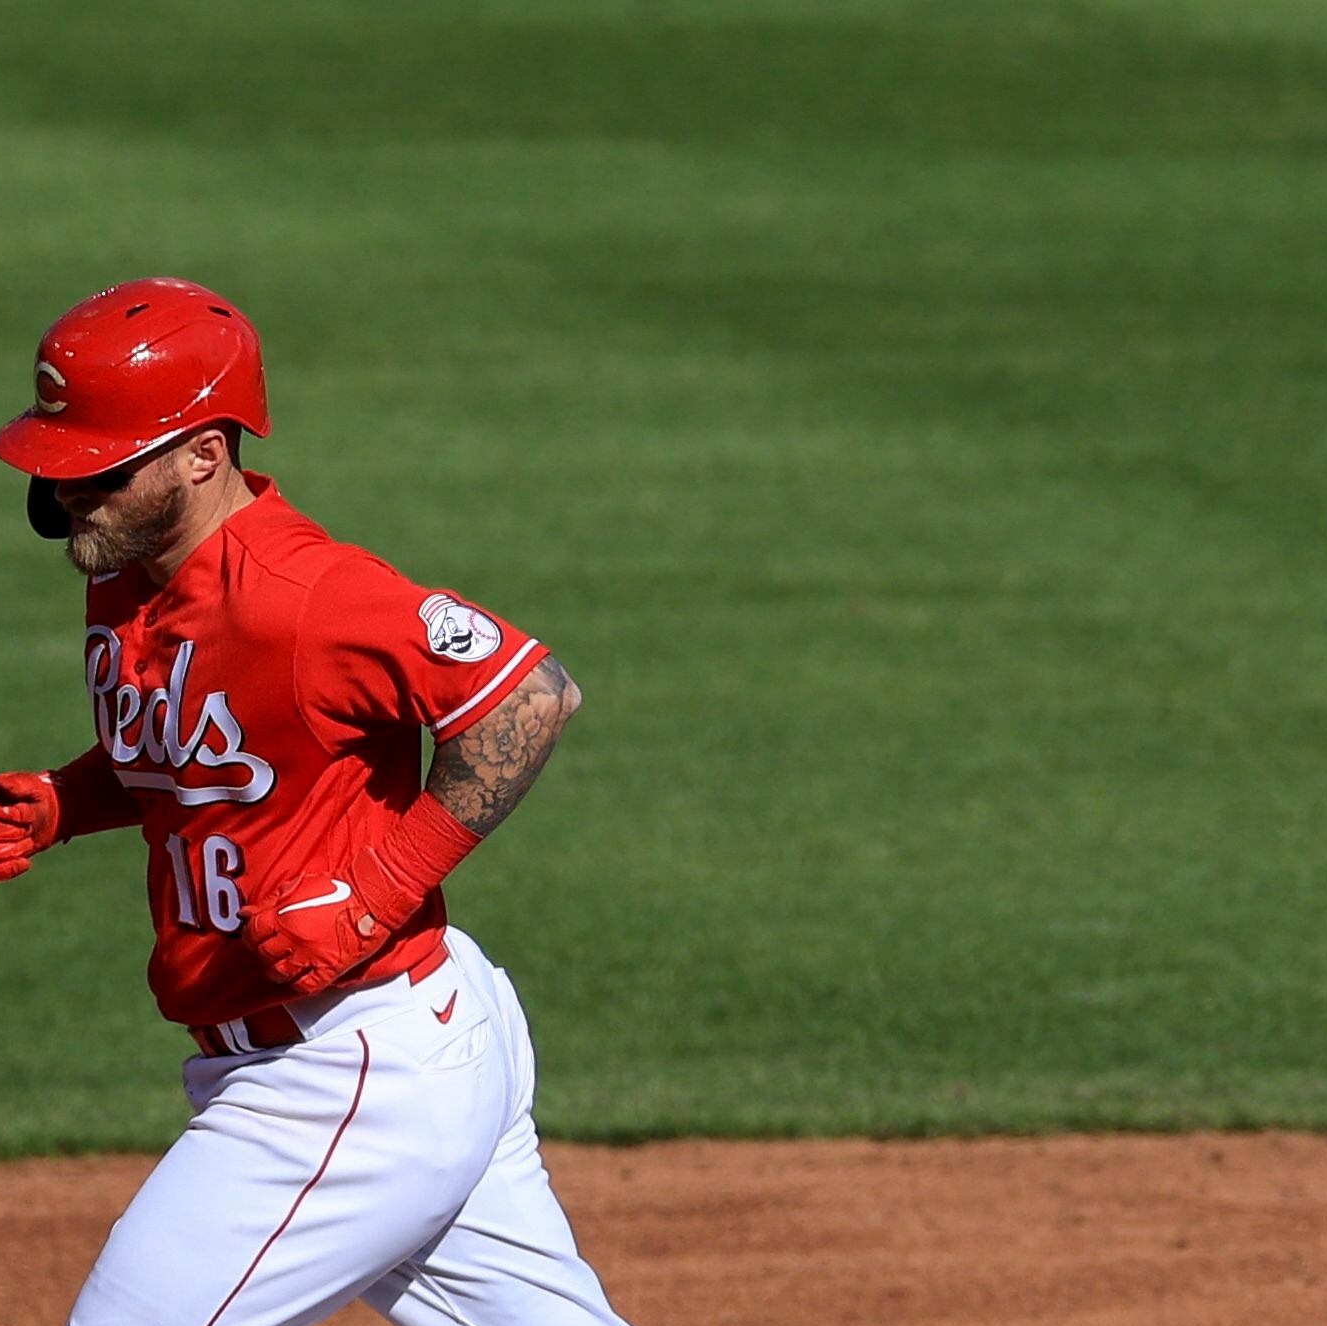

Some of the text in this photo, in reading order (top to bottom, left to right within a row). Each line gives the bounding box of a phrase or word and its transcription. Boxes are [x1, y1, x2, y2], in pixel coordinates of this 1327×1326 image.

[35, 361, 67, 413] C
[85, 624, 274, 806] Reds
[165, 833, 244, 933] 16
